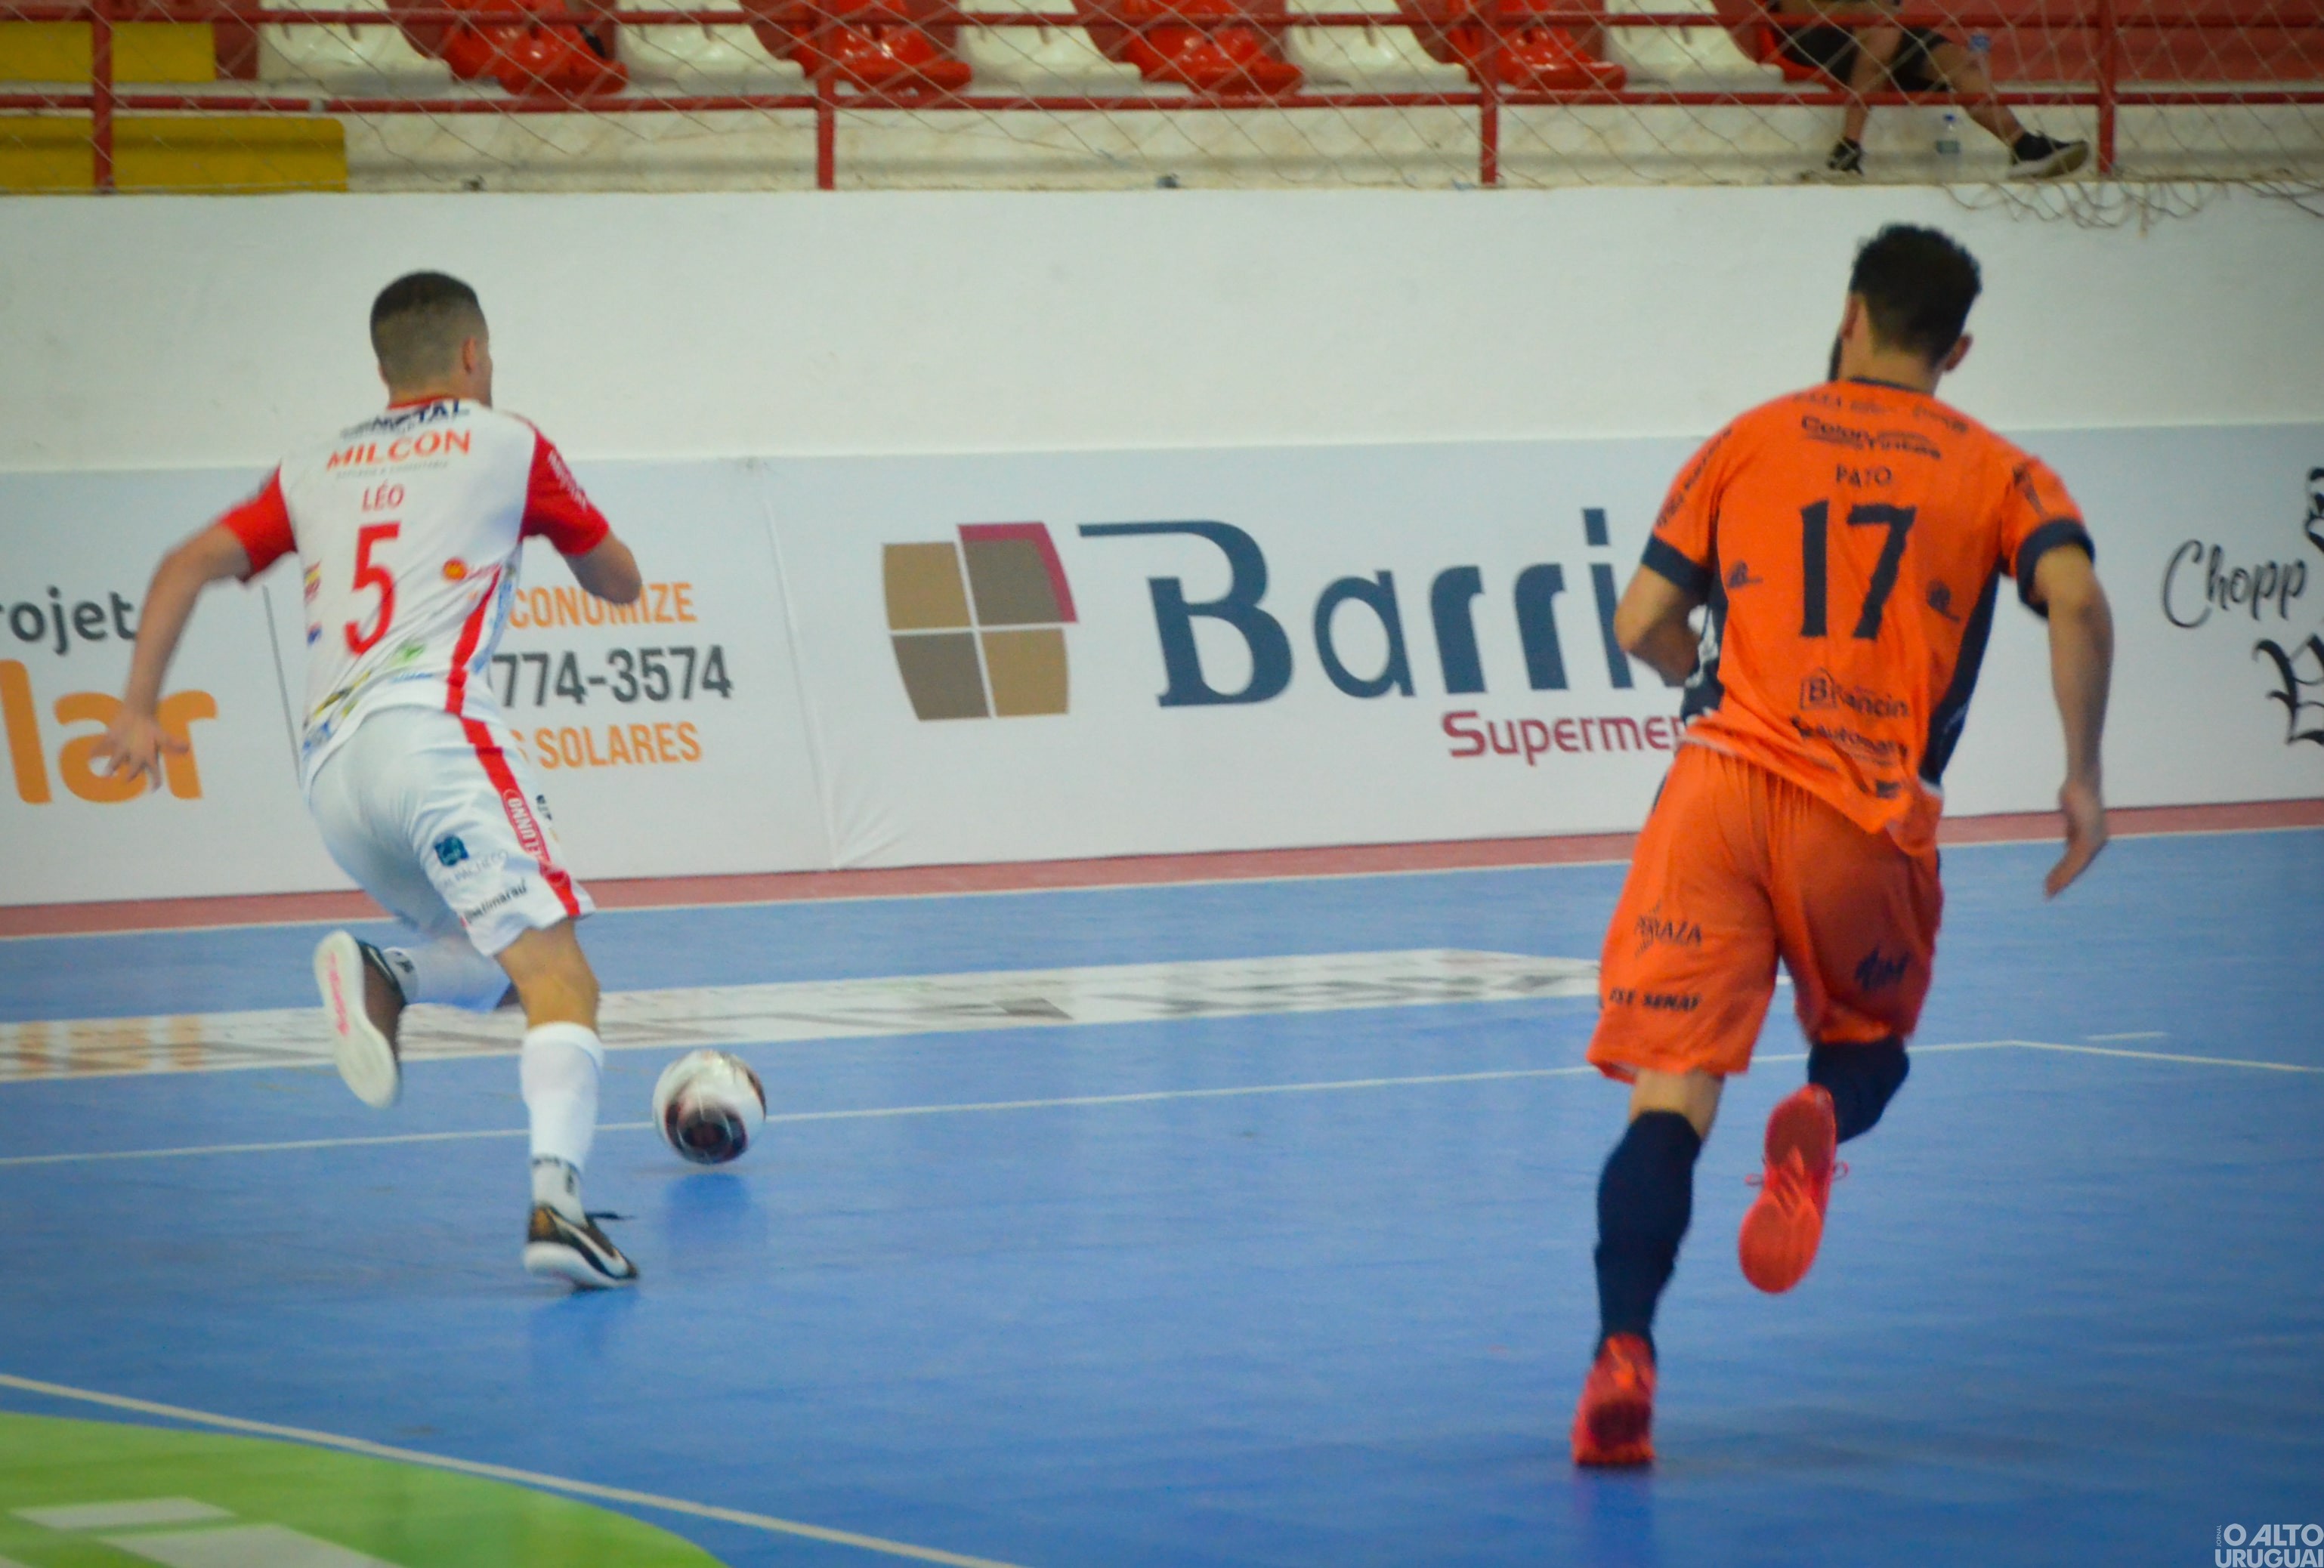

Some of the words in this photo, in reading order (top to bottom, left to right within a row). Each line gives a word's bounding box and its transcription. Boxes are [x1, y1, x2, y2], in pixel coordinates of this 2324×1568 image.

[326, 429, 471, 471] MILCON
[1836, 463, 1893, 488] PATO
[361, 480, 404, 512] LÉO
[344, 521, 400, 656] 5
[1800, 499, 1918, 640] 17
[2162, 539, 2307, 628] Chopp
[0, 585, 137, 656] ojet
[1078, 507, 1689, 708] Barri
[535, 721, 703, 770] SOLARES
